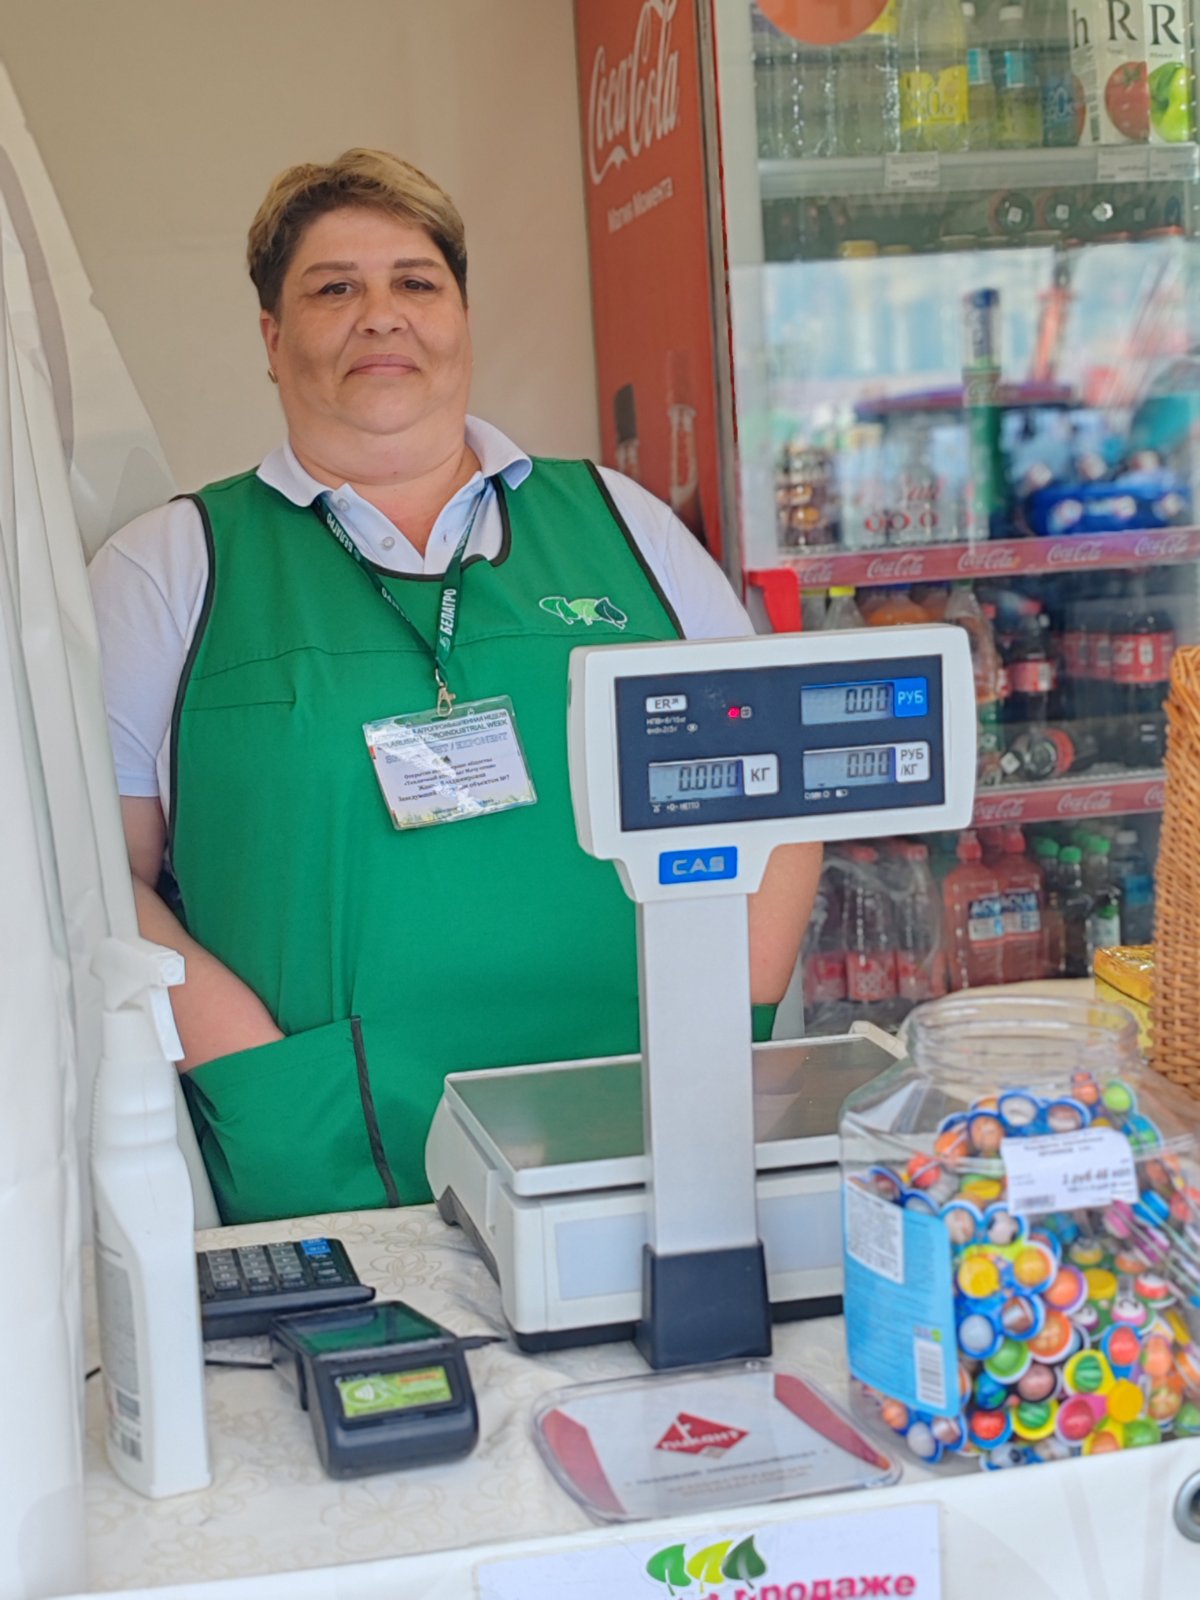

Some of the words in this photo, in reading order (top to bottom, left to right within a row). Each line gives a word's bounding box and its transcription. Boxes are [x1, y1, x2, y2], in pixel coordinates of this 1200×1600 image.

[1151, 4, 1182, 46] R
[326, 512, 354, 553] БЕЛАГРО
[440, 588, 458, 636] БЕЛАГРО
[844, 685, 890, 714] 0.00
[897, 689, 925, 706] РУБ
[486, 718, 508, 731] WEEK
[846, 751, 891, 778] 0.00
[900, 747, 925, 761] РУБ
[678, 762, 739, 792] 0.000
[750, 767, 771, 782] КГ
[672, 855, 725, 876] CAS
